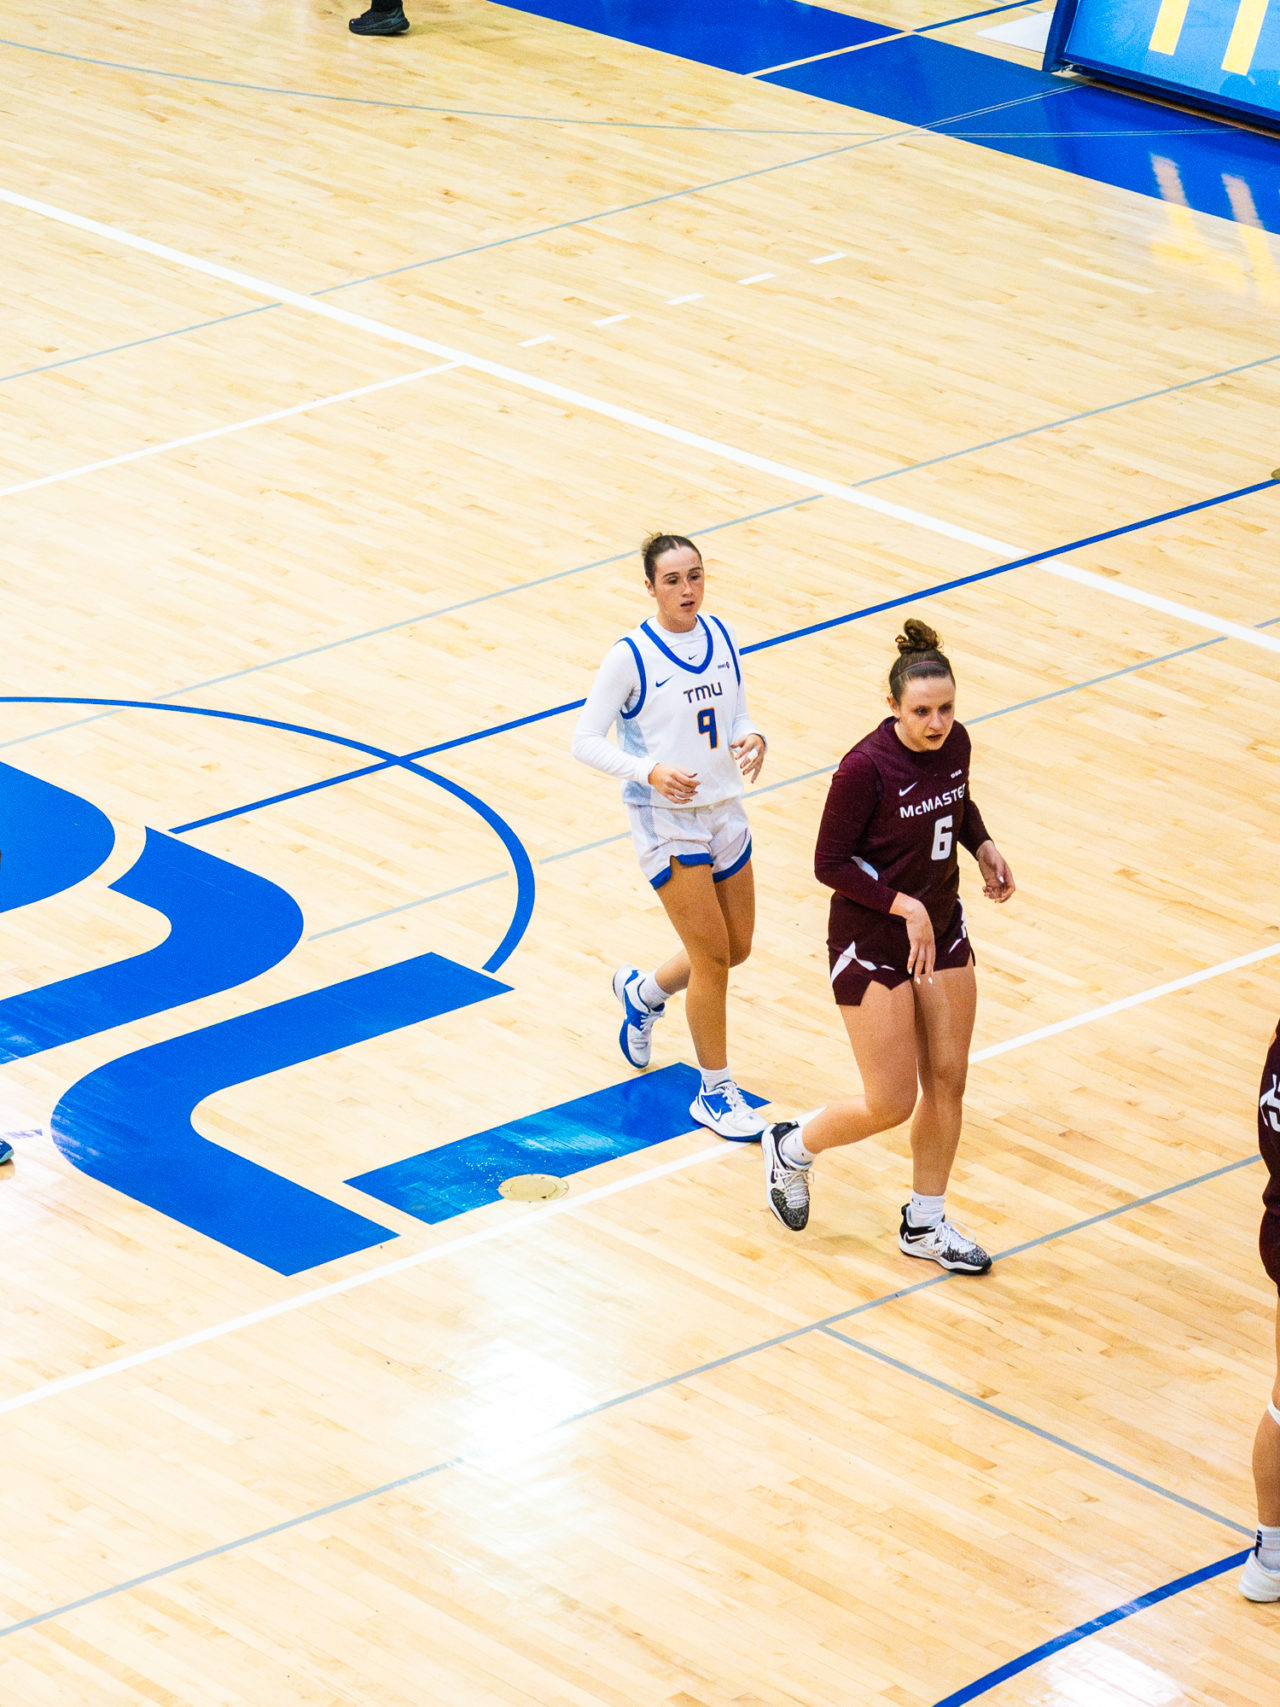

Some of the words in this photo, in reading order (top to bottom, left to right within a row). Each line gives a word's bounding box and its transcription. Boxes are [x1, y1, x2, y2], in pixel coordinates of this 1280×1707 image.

[683, 681, 723, 704] TMU
[696, 706, 719, 751] 9
[931, 815, 953, 861] 6
